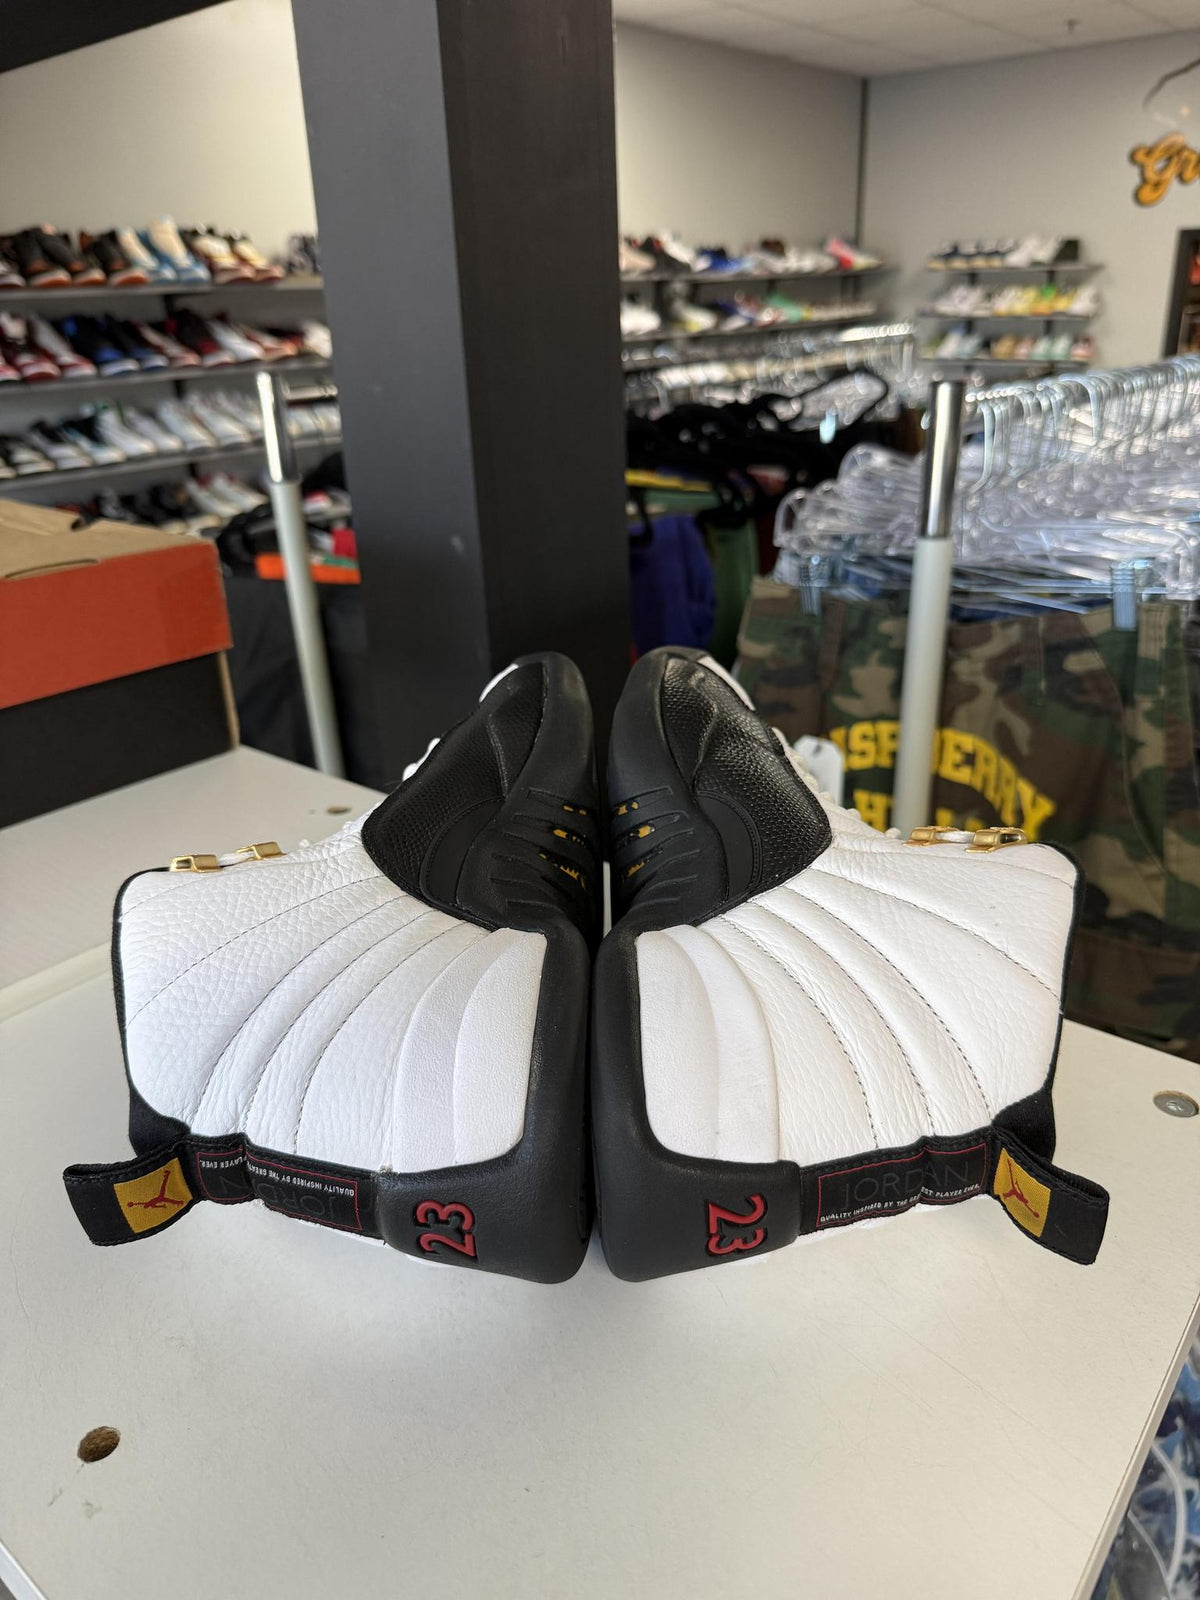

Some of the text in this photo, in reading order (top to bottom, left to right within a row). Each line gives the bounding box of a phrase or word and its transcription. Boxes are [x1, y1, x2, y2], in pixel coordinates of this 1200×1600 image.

[1129, 132, 1200, 206] Gr
[268, 1170, 280, 1181] THE
[281, 1174, 292, 1183] BY
[293, 1177, 323, 1190] INSPIRED
[324, 1184, 355, 1197] QUALITY
[820, 1210, 852, 1223] QUALITY
[852, 1202, 882, 1216] INSPIRED
[884, 1200, 894, 1208] BY
[896, 1199, 908, 1208] THE
[935, 1188, 962, 1198] PLAYER
[416, 1199, 476, 1257] 23
[708, 1193, 765, 1254] 23
